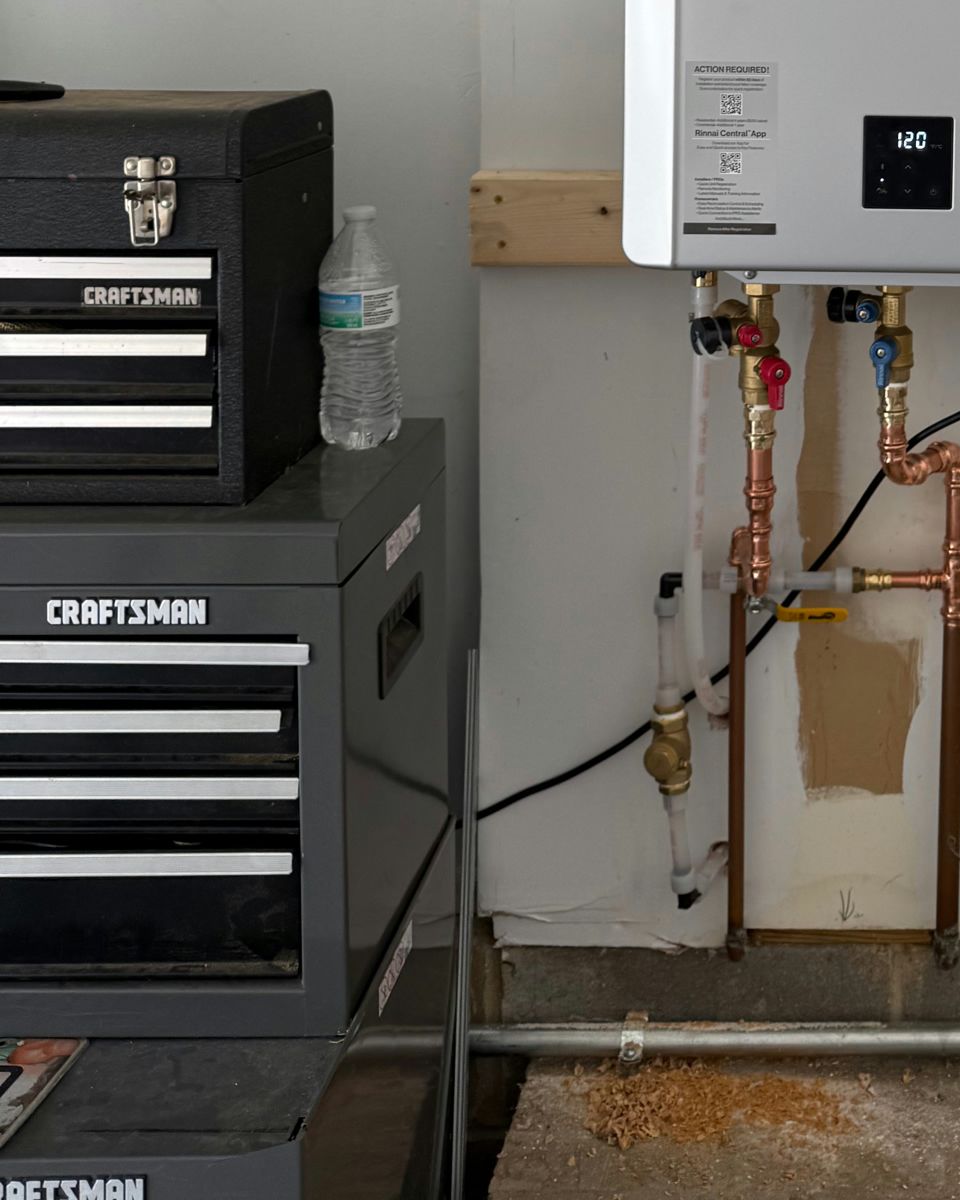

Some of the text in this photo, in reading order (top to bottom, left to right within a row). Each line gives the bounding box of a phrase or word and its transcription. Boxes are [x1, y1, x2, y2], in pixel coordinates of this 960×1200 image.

[726, 66, 770, 74] REQUIRED!
[695, 129, 719, 137] Rinnai
[751, 130, 767, 138] App
[897, 131, 927, 149] 120
[84, 286, 198, 306] CRAFTSMAN
[46, 599, 207, 625] CRAFTSMAN
[0, 1179, 145, 1200] AFTSMAN
